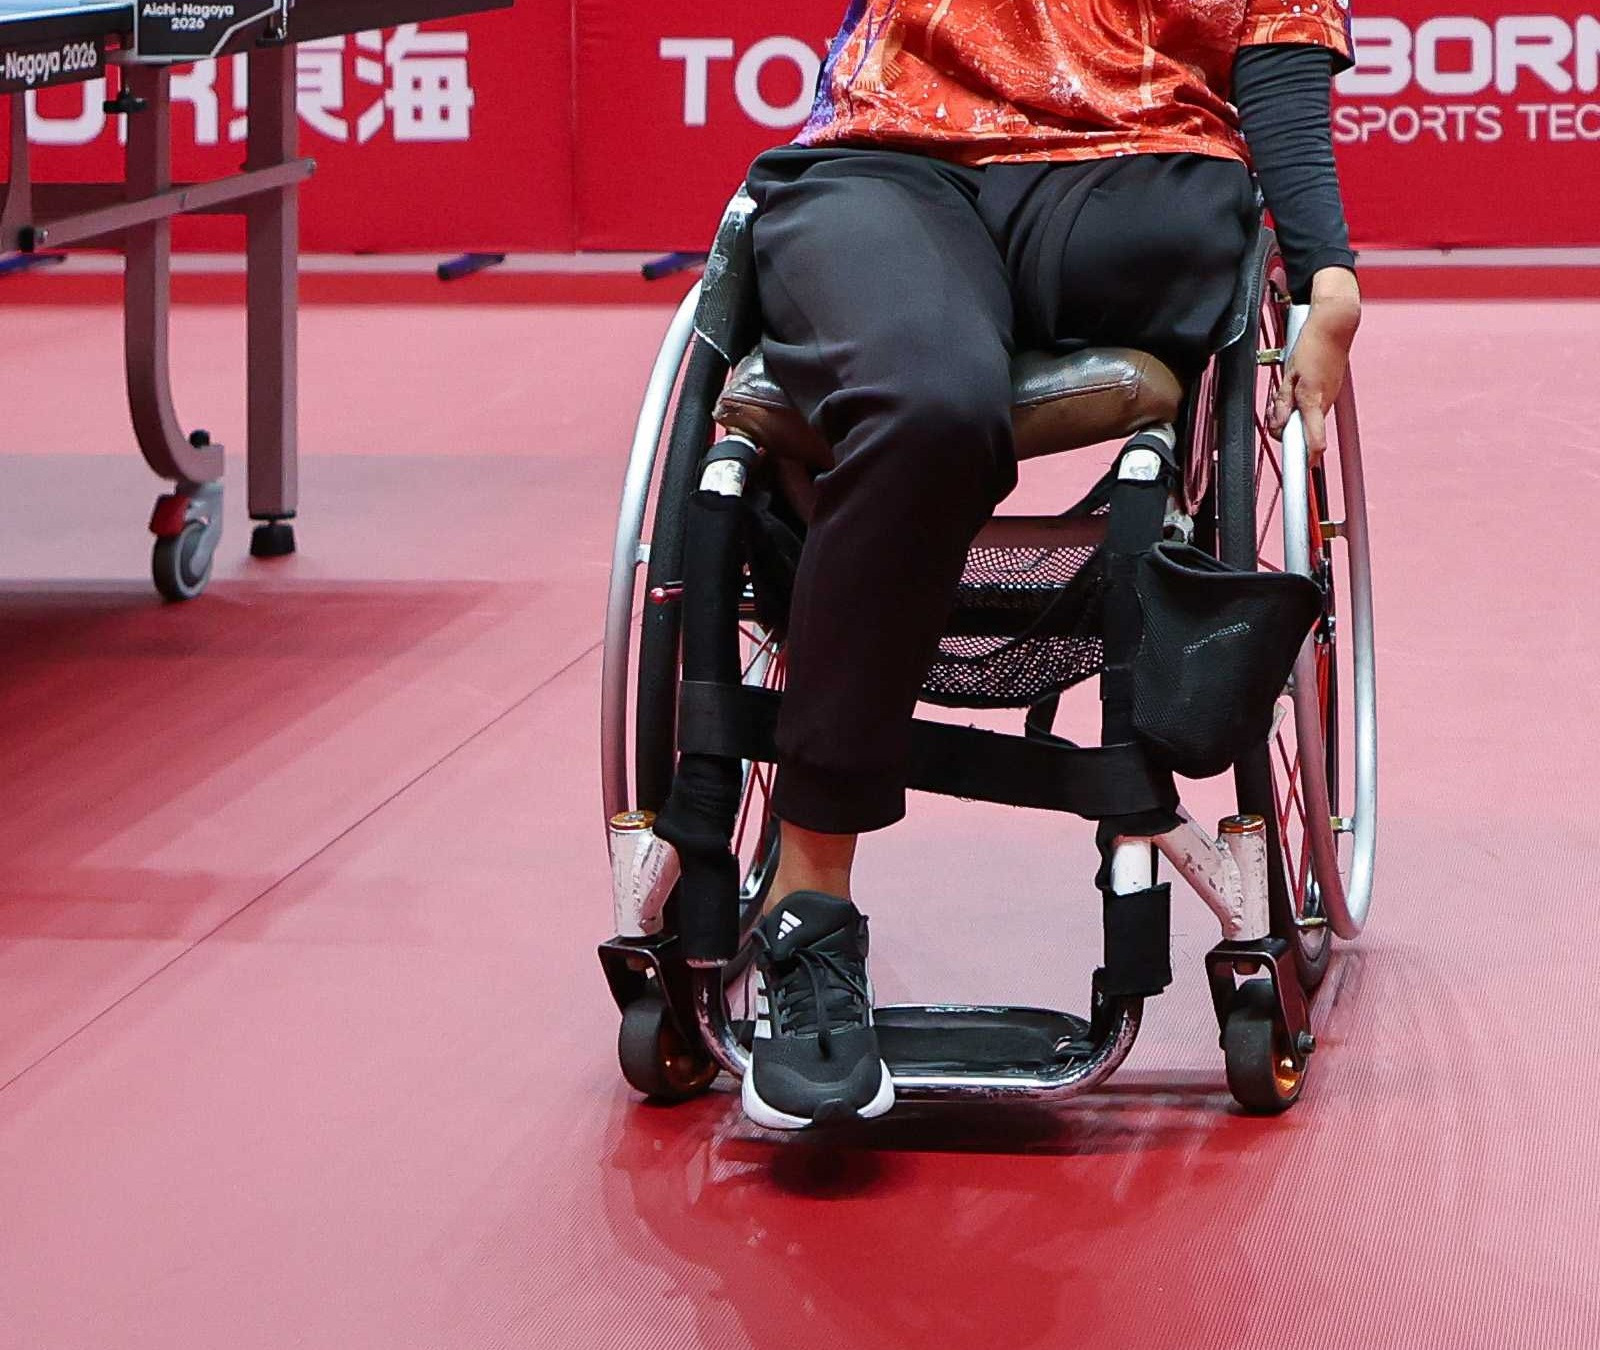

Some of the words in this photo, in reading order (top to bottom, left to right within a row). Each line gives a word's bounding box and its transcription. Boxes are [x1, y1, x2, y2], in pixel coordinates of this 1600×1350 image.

[170, 16, 206, 31] 2026
[62, 40, 98, 73] 2026
[1334, 103, 1502, 144] SPORTS
